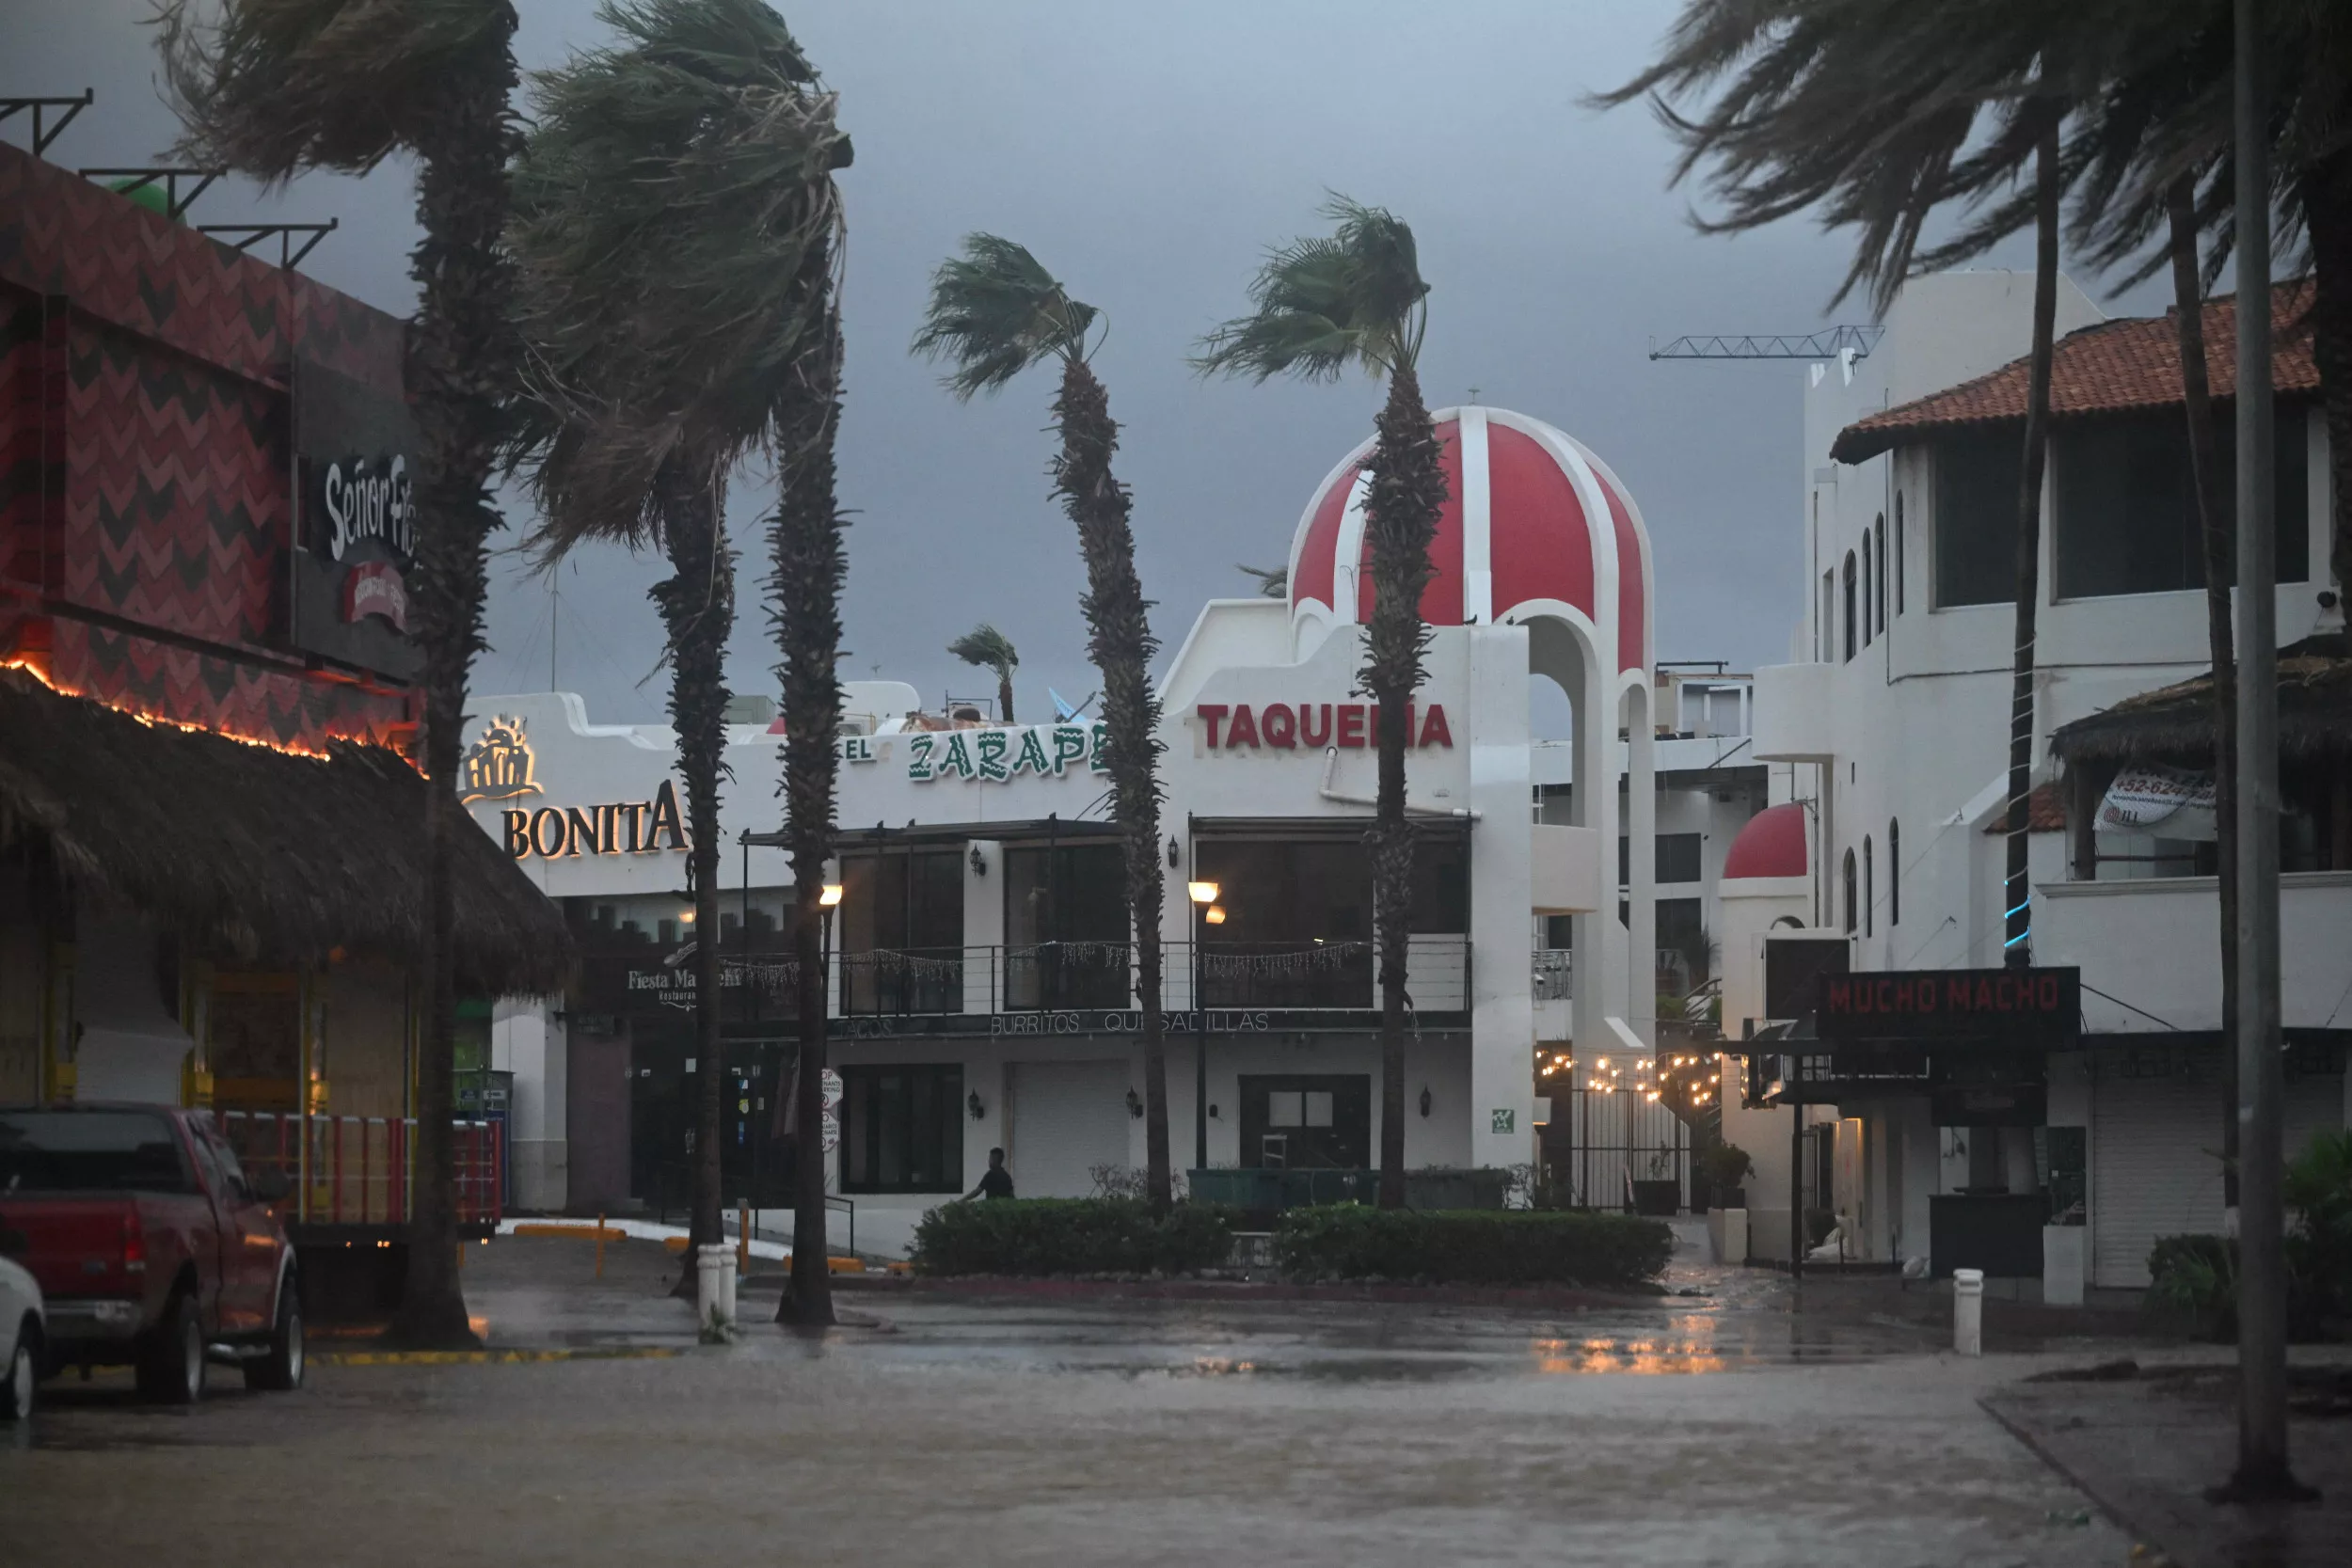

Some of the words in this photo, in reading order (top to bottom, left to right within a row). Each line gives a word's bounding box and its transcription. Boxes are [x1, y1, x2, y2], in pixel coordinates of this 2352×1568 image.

[846, 739, 871, 760] EL
[501, 779, 689, 858] BONITA
[628, 970, 669, 990] Fiesta
[674, 968, 742, 989] Machi
[659, 990, 697, 1001] Restauran
[1829, 979, 1937, 1014] MUCHO
[1947, 974, 2059, 1011] MACHO
[991, 1013, 1080, 1035] BURRITOS
